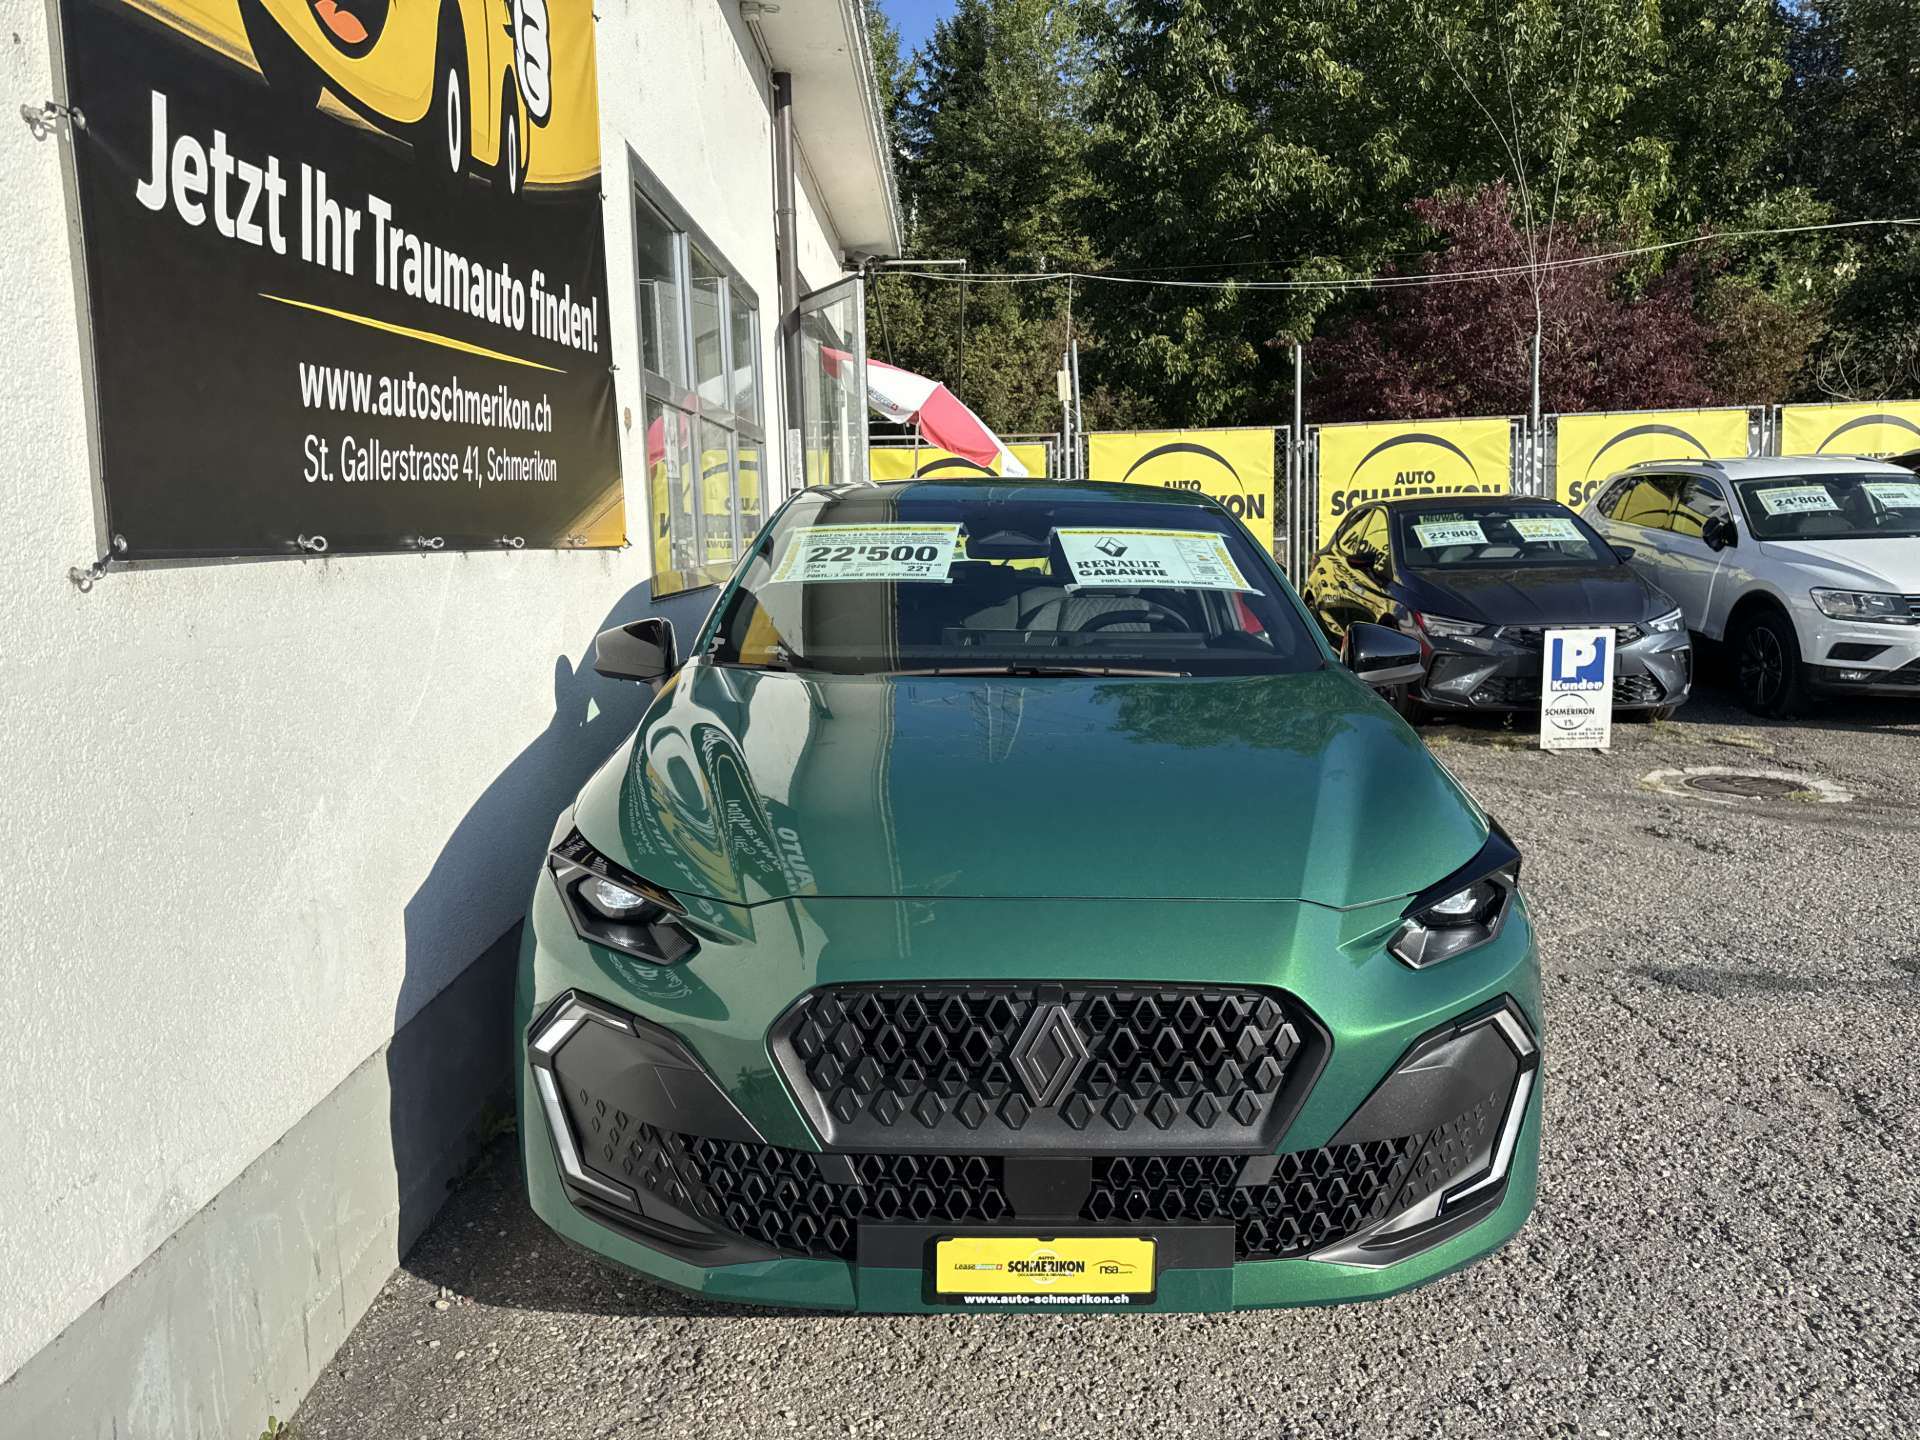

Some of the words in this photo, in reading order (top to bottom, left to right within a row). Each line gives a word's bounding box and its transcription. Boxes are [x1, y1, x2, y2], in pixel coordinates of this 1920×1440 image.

[136, 89, 287, 255] Jetzt
[301, 162, 361, 276] Ihr
[368, 193, 525, 331] Traumauto
[530, 268, 598, 354] finden!
[299, 362, 552, 432] www.autoschmerikon.ch
[304, 434, 334, 483] St.
[341, 435, 459, 482] Gallerstrasse
[462, 445, 482, 489] 41,
[487, 446, 557, 482] Schmerikon
[1395, 470, 1435, 485] AUTO
[1774, 496, 1828, 507] 24'800
[1428, 530, 1478, 539] 22'800
[806, 545, 939, 563] 22'500
[1076, 560, 1161, 569] RENAULT
[1078, 569, 1169, 577] GARANTIE
[1551, 679, 1604, 691] Kunden
[1545, 707, 1596, 716] SCHMERIKON
[1007, 1260, 1086, 1273] SCHMERIKON
[1099, 1266, 1119, 1275] nsa
[964, 1294, 1130, 1305] www.auto-schmerikon.ch
